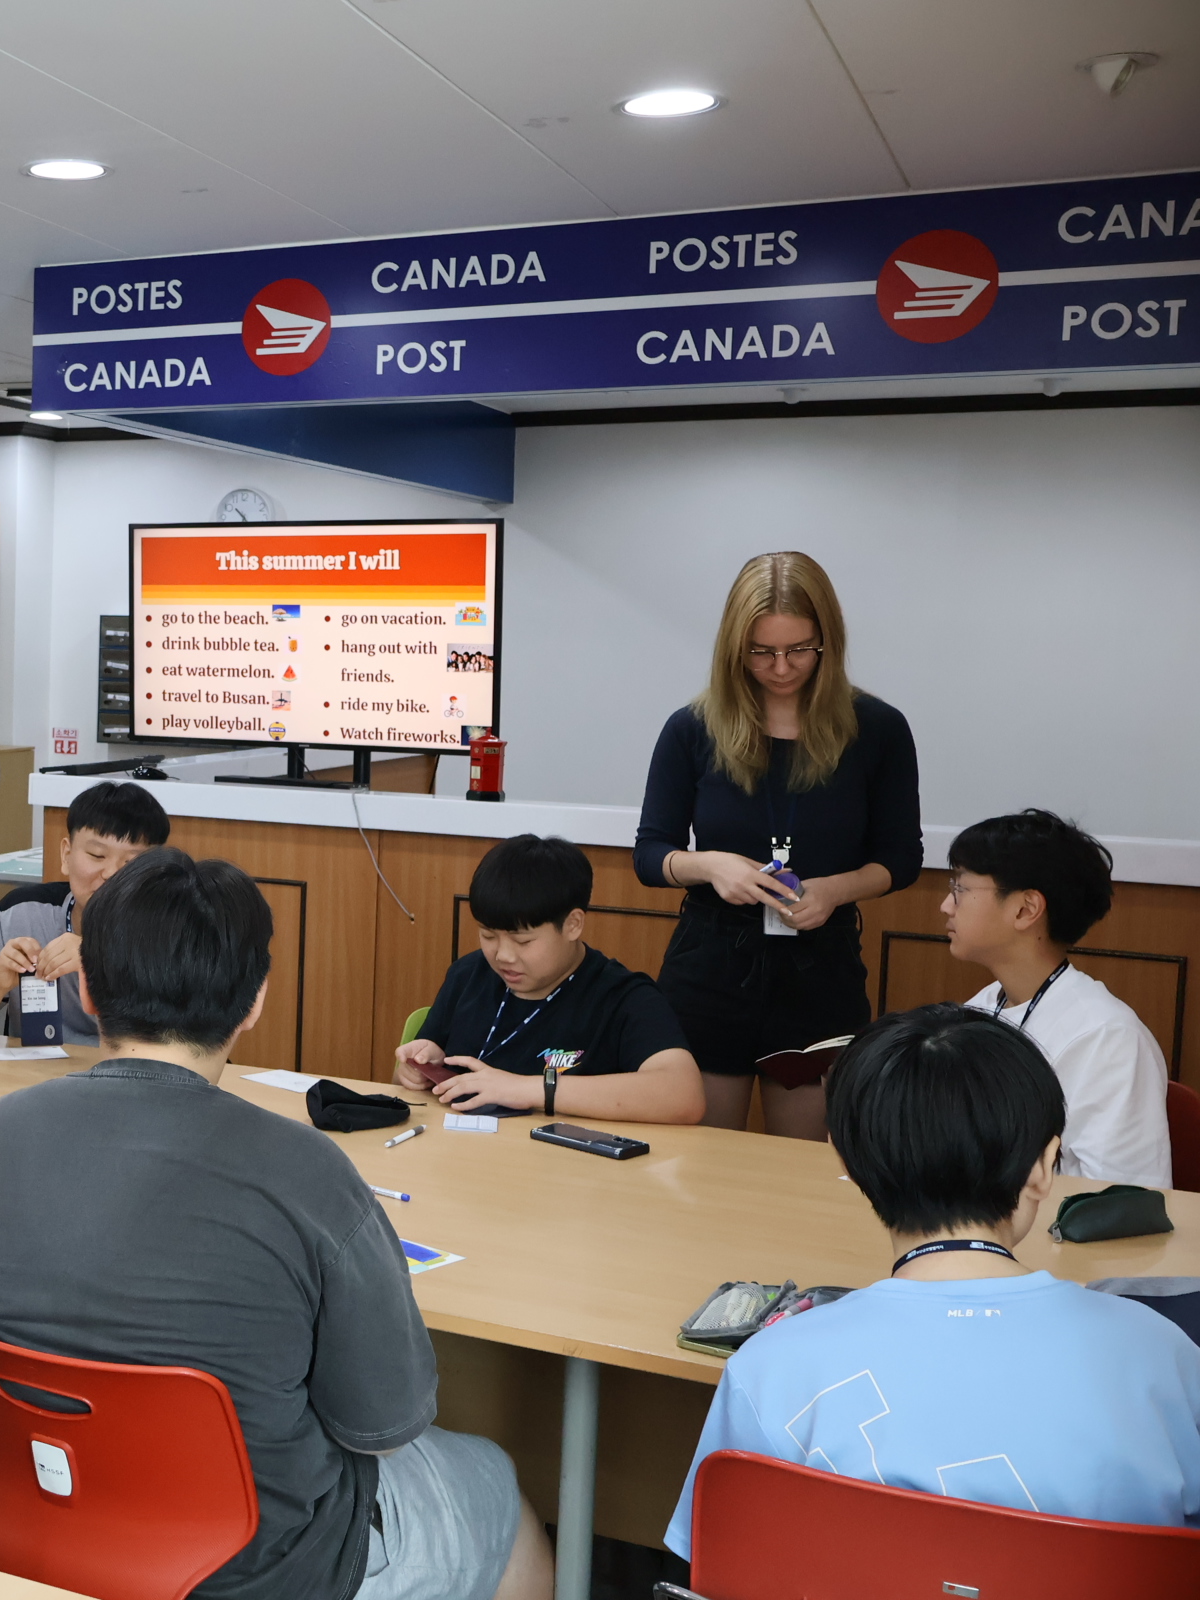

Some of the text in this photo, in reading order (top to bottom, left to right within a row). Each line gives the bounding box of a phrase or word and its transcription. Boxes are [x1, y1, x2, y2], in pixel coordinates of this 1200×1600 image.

[1057, 198, 1200, 244] CANA
[648, 230, 798, 274] POSTES
[371, 251, 546, 294] CANADA
[72, 279, 183, 316] POSTES
[1061, 299, 1187, 342] POST
[636, 322, 835, 365] CANADA
[376, 340, 467, 375] POST
[64, 357, 212, 393] CANADA
[216, 548, 401, 571] This summer I will
[161, 610, 269, 628] go to the beach.
[341, 611, 446, 628] go on vacation.
[161, 636, 279, 652] drink bubble tea.
[341, 640, 438, 657] hang out with
[161, 664, 275, 679] eat watermelon.
[341, 668, 395, 683] friends.
[161, 689, 270, 705] travel to Busan.
[340, 697, 430, 715] ride my bike.
[161, 714, 266, 733] play volleyball.
[340, 727, 460, 745] Watch fireworks.
[549, 1053, 577, 1068] NIKE
[947, 1309, 974, 1318] MLB
